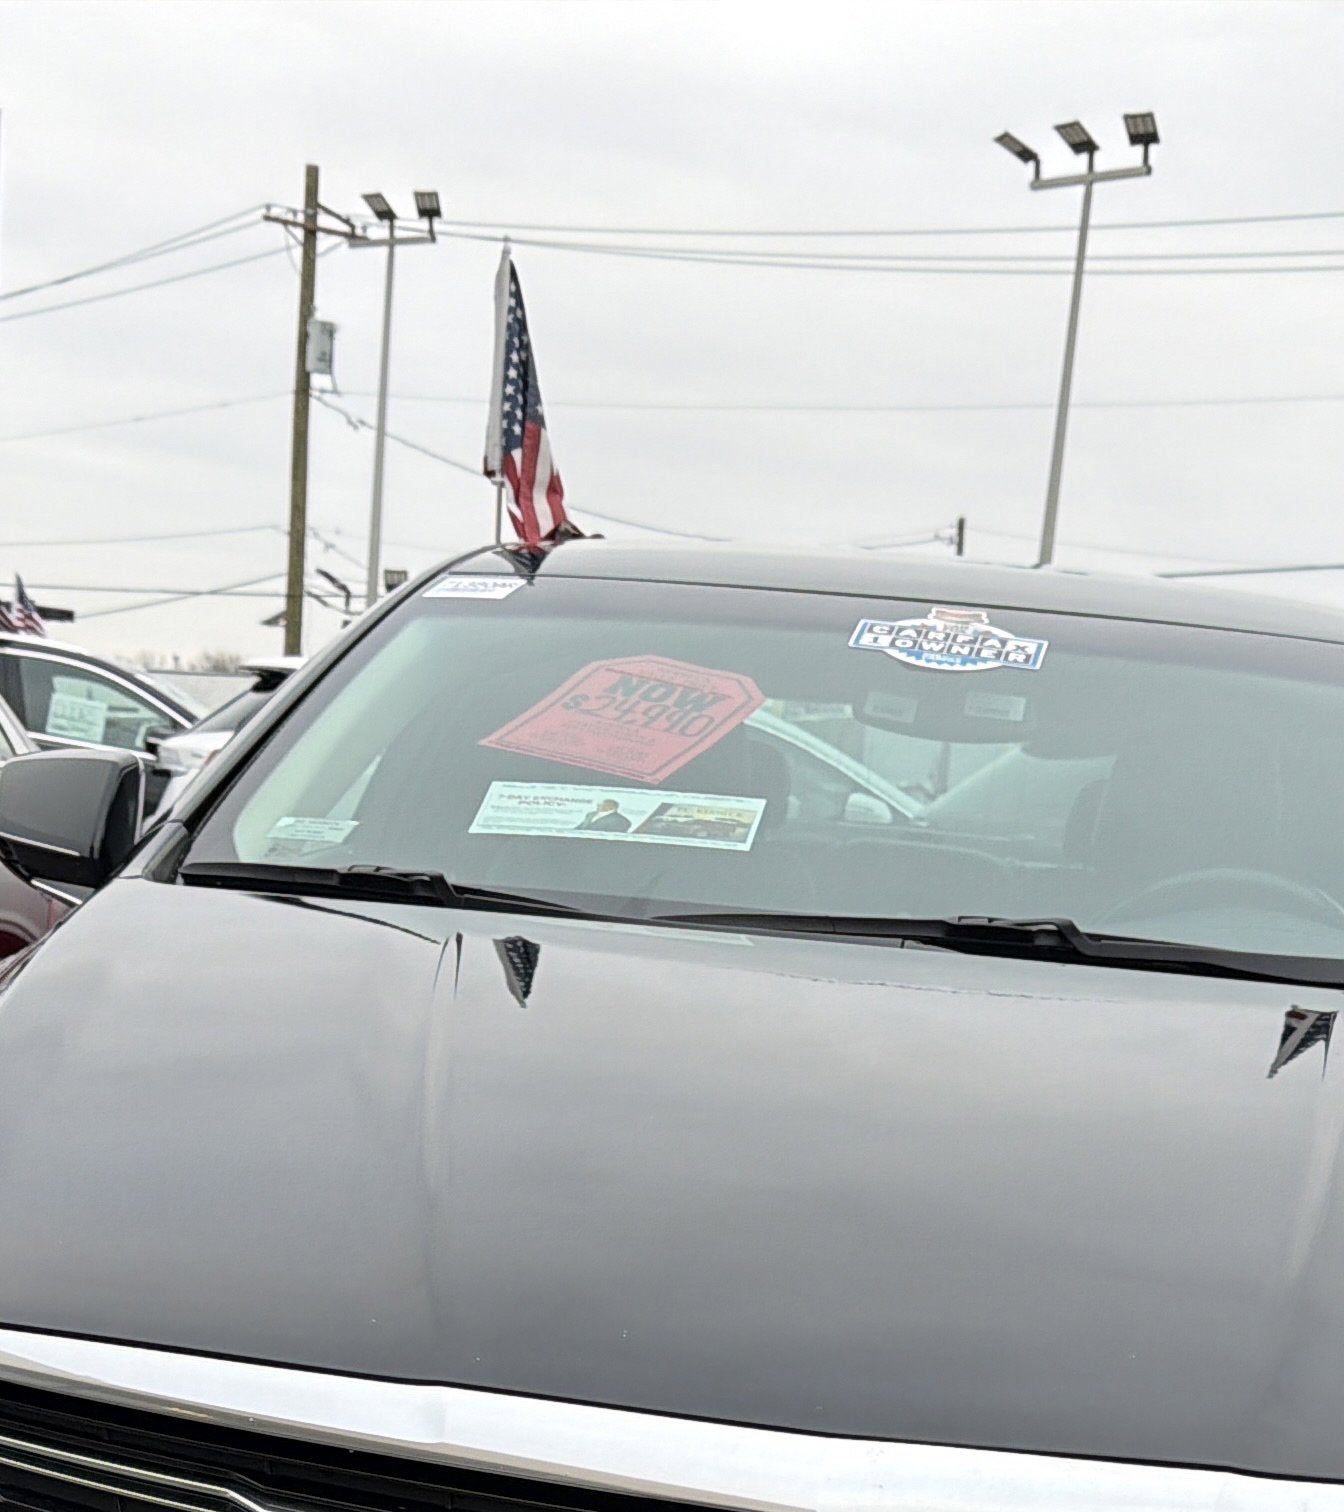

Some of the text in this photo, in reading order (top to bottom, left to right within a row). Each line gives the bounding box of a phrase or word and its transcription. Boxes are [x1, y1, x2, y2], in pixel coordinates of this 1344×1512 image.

[872, 624, 1033, 652] CARFAX
[894, 639, 1027, 663] OWNER
[605, 674, 727, 712] NOW
